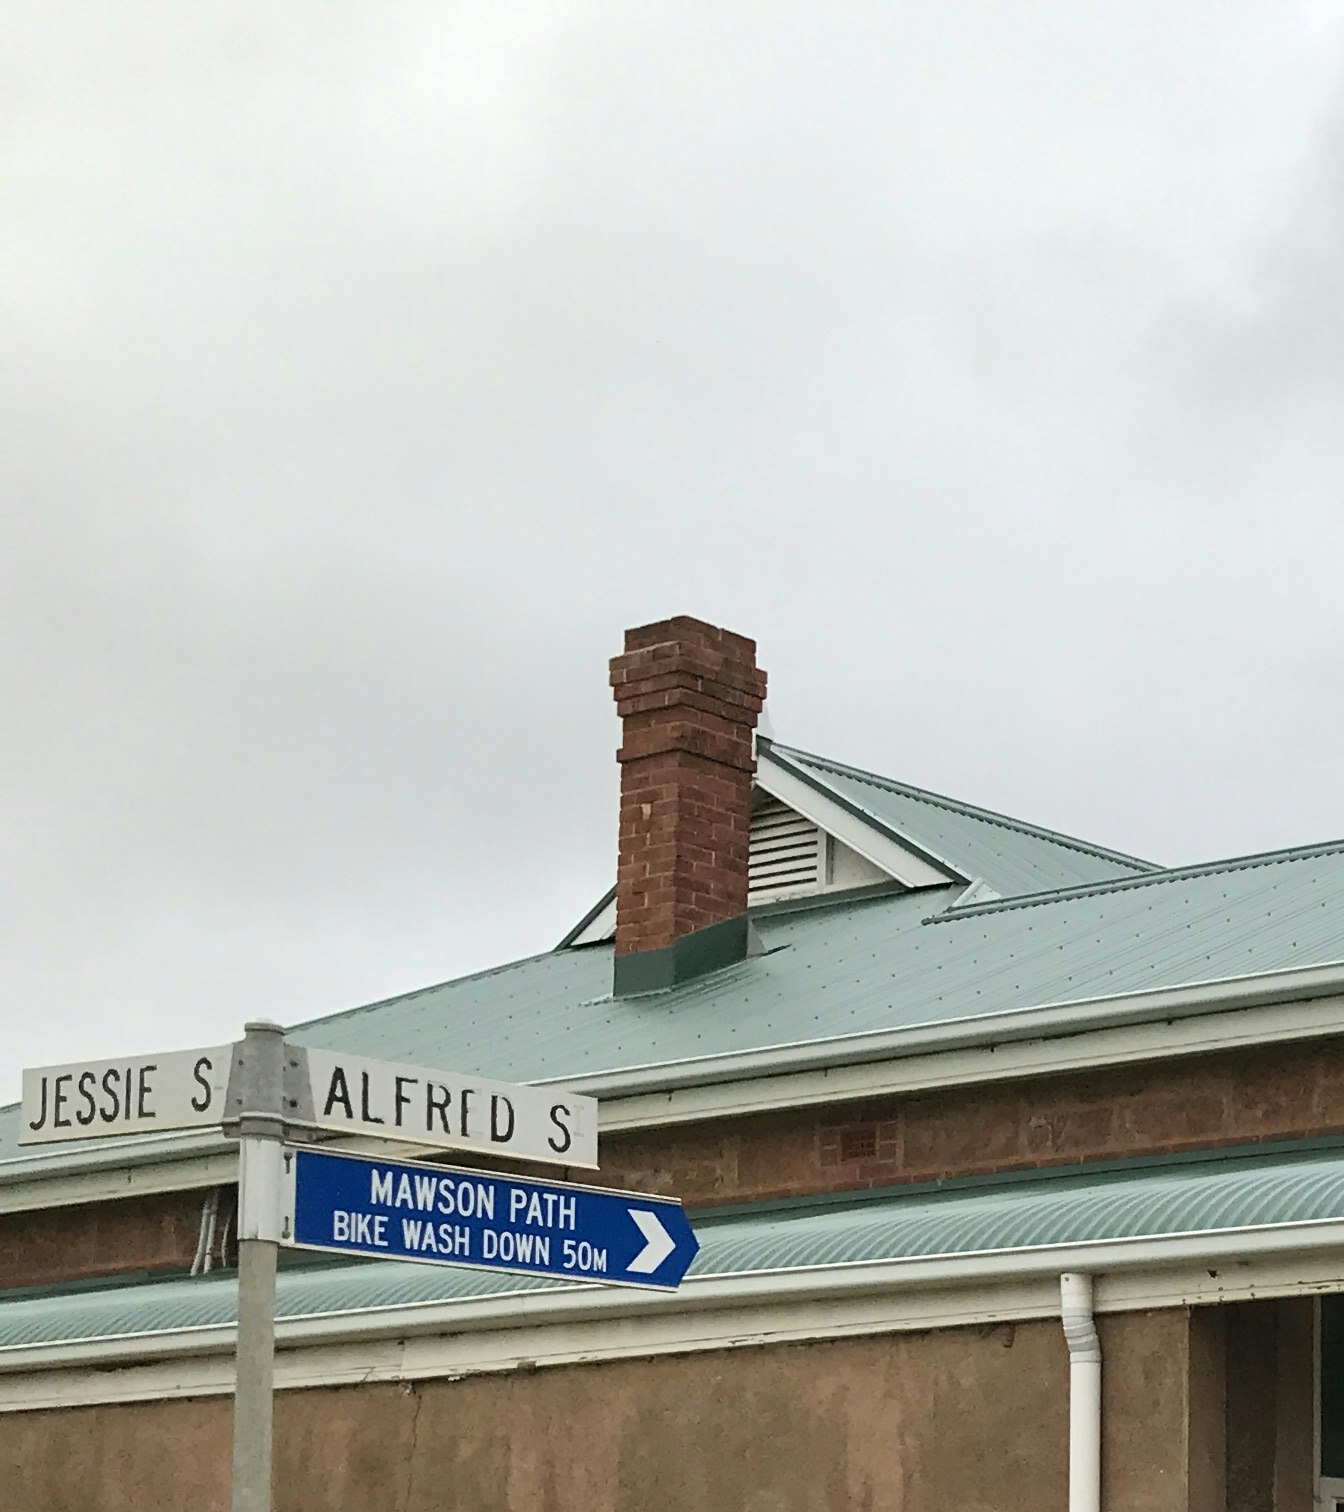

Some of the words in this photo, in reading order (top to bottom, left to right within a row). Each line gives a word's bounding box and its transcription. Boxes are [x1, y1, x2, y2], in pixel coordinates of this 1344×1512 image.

[30, 1064, 157, 1130] JESSIE
[370, 1169, 495, 1221] MAWSON
[510, 1188, 576, 1231] PATH
[333, 1210, 389, 1246] BIKE
[402, 1218, 470, 1256] WASH
[483, 1229, 550, 1266] DOWN
